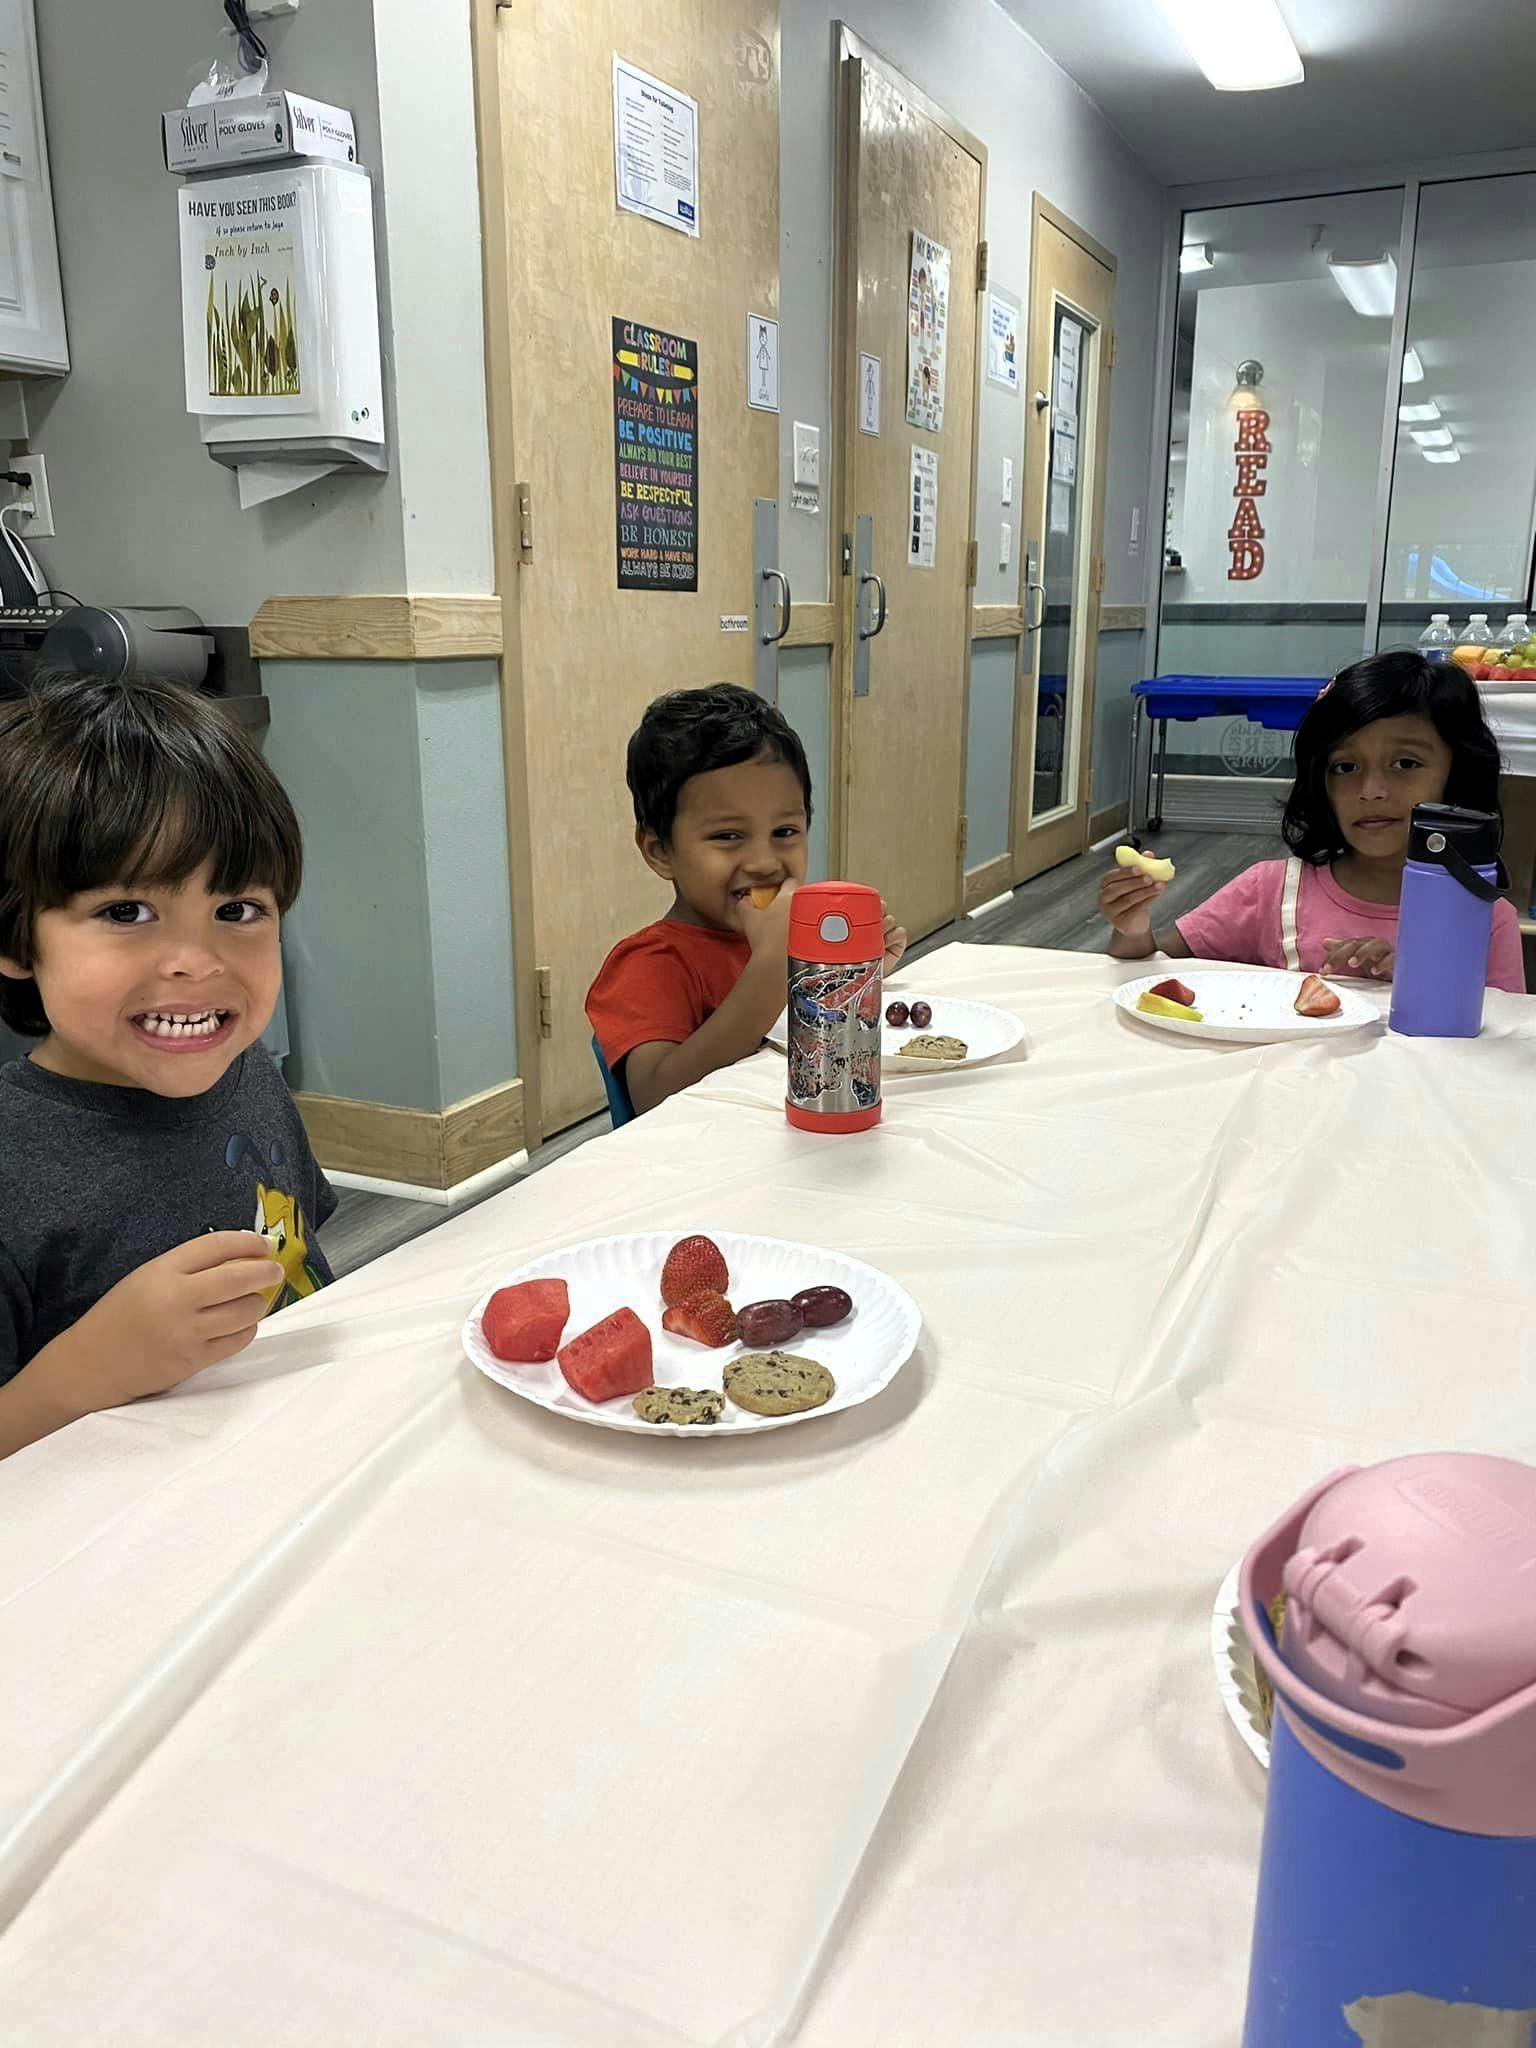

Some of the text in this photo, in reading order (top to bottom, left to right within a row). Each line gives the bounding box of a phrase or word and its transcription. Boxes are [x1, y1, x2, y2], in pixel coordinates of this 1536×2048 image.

[180, 114, 208, 148] Silver
[219, 124, 236, 136] POLY
[238, 121, 266, 133] GLOVES
[292, 105, 316, 134] Silver
[322, 125, 336, 136] POLY
[188, 191, 297, 217] HAVE YOU SEEN THIS BOOK?
[230, 224, 246, 237] please
[246, 222, 264, 233] return
[264, 220, 271, 229] to
[214, 246, 234, 257] Inch
[237, 244, 248, 258] by
[251, 241, 270, 255] Inch
[623, 323, 687, 360] CLASSROOM
[617, 397, 694, 429] PREPARE TO LEARN
[618, 419, 693, 451] BE POSITIVE
[619, 442, 692, 470] ALWAYS DO YOUR BEST
[619, 462, 693, 487] BELIEVE IN YOURSELF
[620, 480, 693, 507] BE RESPECTFUL
[1227, 409, 1272, 581] READ
[620, 502, 693, 527] ASK QUESTIONS
[620, 524, 694, 548] BE HONEST
[620, 547, 640, 560] WORK
[640, 548, 658, 560] HARD
[664, 550, 681, 562] HAVE
[681, 551, 694, 564] FUN
[620, 560, 695, 580] ALWAYS BE KIND
